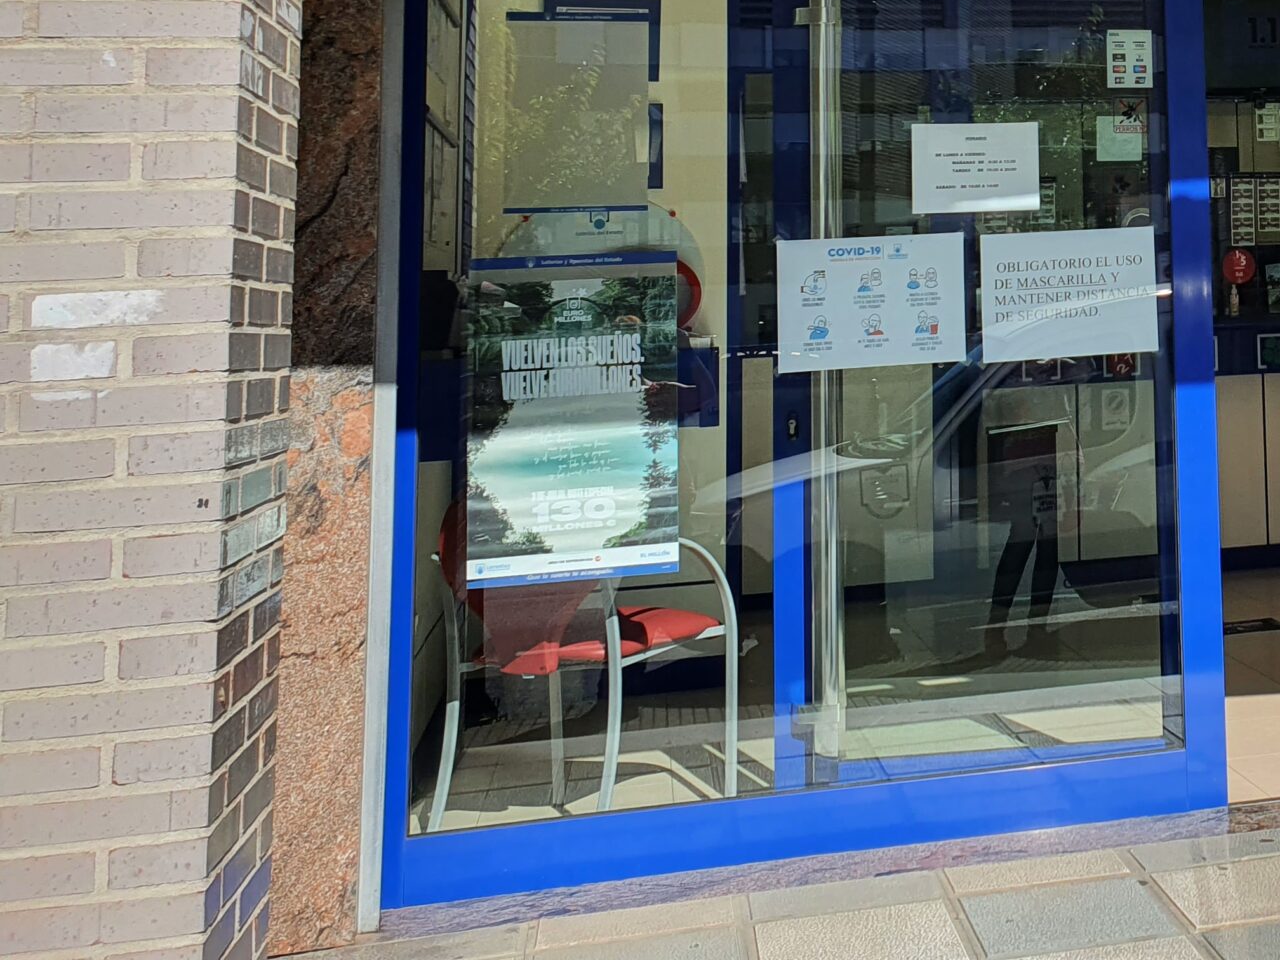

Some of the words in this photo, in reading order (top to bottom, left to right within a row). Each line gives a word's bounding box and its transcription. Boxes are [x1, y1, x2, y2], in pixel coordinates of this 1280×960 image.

[828, 246, 881, 257] COVID-19
[996, 257, 1092, 273] OBLIGATORIO
[1096, 256, 1112, 268] EL
[1116, 254, 1142, 266] USO
[994, 279, 1013, 290] DE
[1016, 273, 1107, 290] MASCARILLA
[1111, 272, 1120, 283] Y
[995, 291, 1072, 306] MANTENER
[1076, 286, 1150, 301] DISTANCIA
[995, 311, 1013, 323] DE
[531, 497, 616, 523] 130
